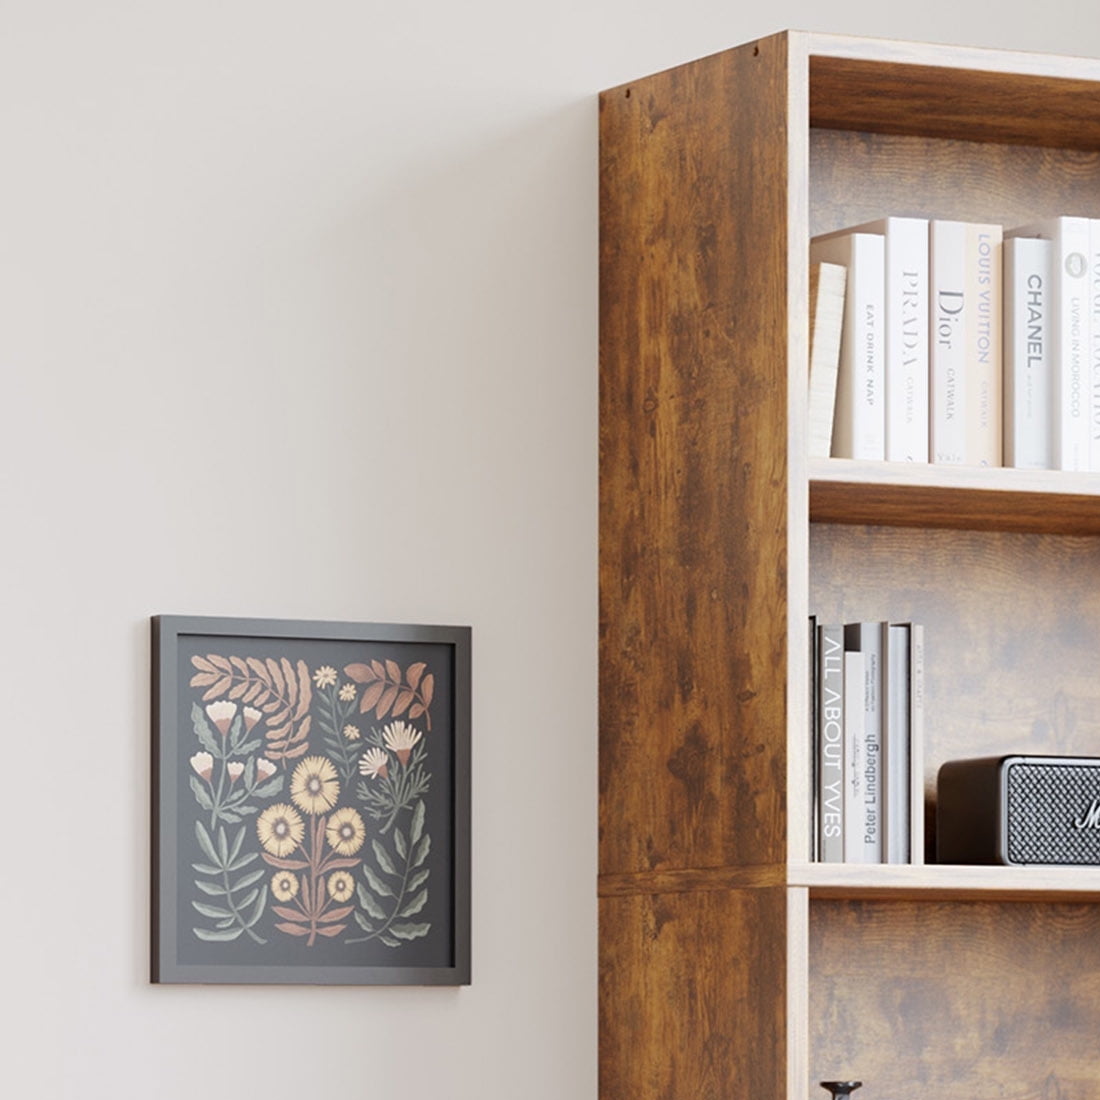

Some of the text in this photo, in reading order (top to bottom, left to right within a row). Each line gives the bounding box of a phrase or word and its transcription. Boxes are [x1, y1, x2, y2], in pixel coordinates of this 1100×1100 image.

[978, 233, 991, 285] LOUIS
[866, 304, 875, 407] EAT DRINK NAP
[902, 270, 919, 368] PRADA
[938, 289, 965, 351] Dior
[978, 290, 991, 364] VUITTON
[1027, 274, 1043, 368] CHANEL
[1071, 297, 1081, 418] LIVING IN MOROCCO
[824, 636, 841, 679] ALL
[824, 687, 841, 770] ABOUT
[824, 779, 841, 838] YVES
[865, 733, 879, 844] Peter Lindbergh
